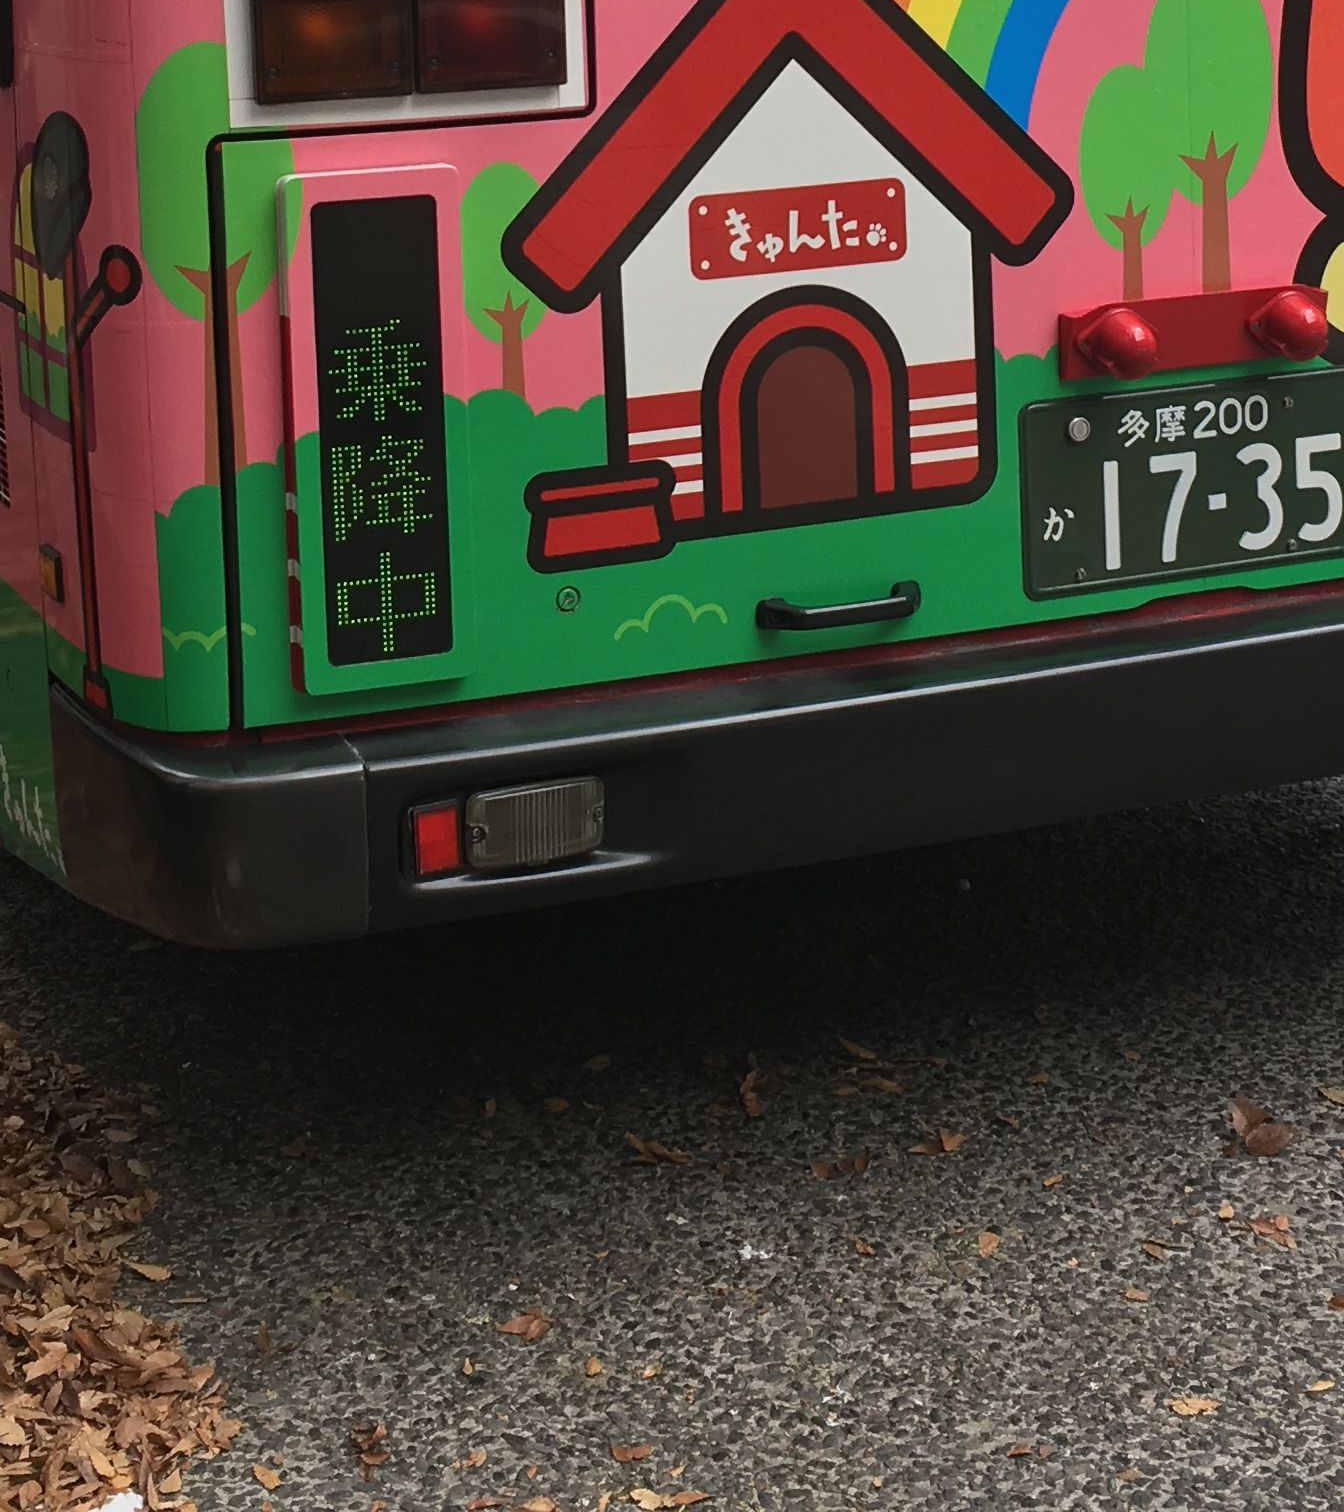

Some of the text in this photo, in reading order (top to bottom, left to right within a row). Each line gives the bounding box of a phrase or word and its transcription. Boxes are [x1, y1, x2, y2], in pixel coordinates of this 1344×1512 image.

[724, 199, 860, 263] きゅんた
[328, 317, 437, 652] 乗降中
[1043, 432, 1343, 571] か 17-35
